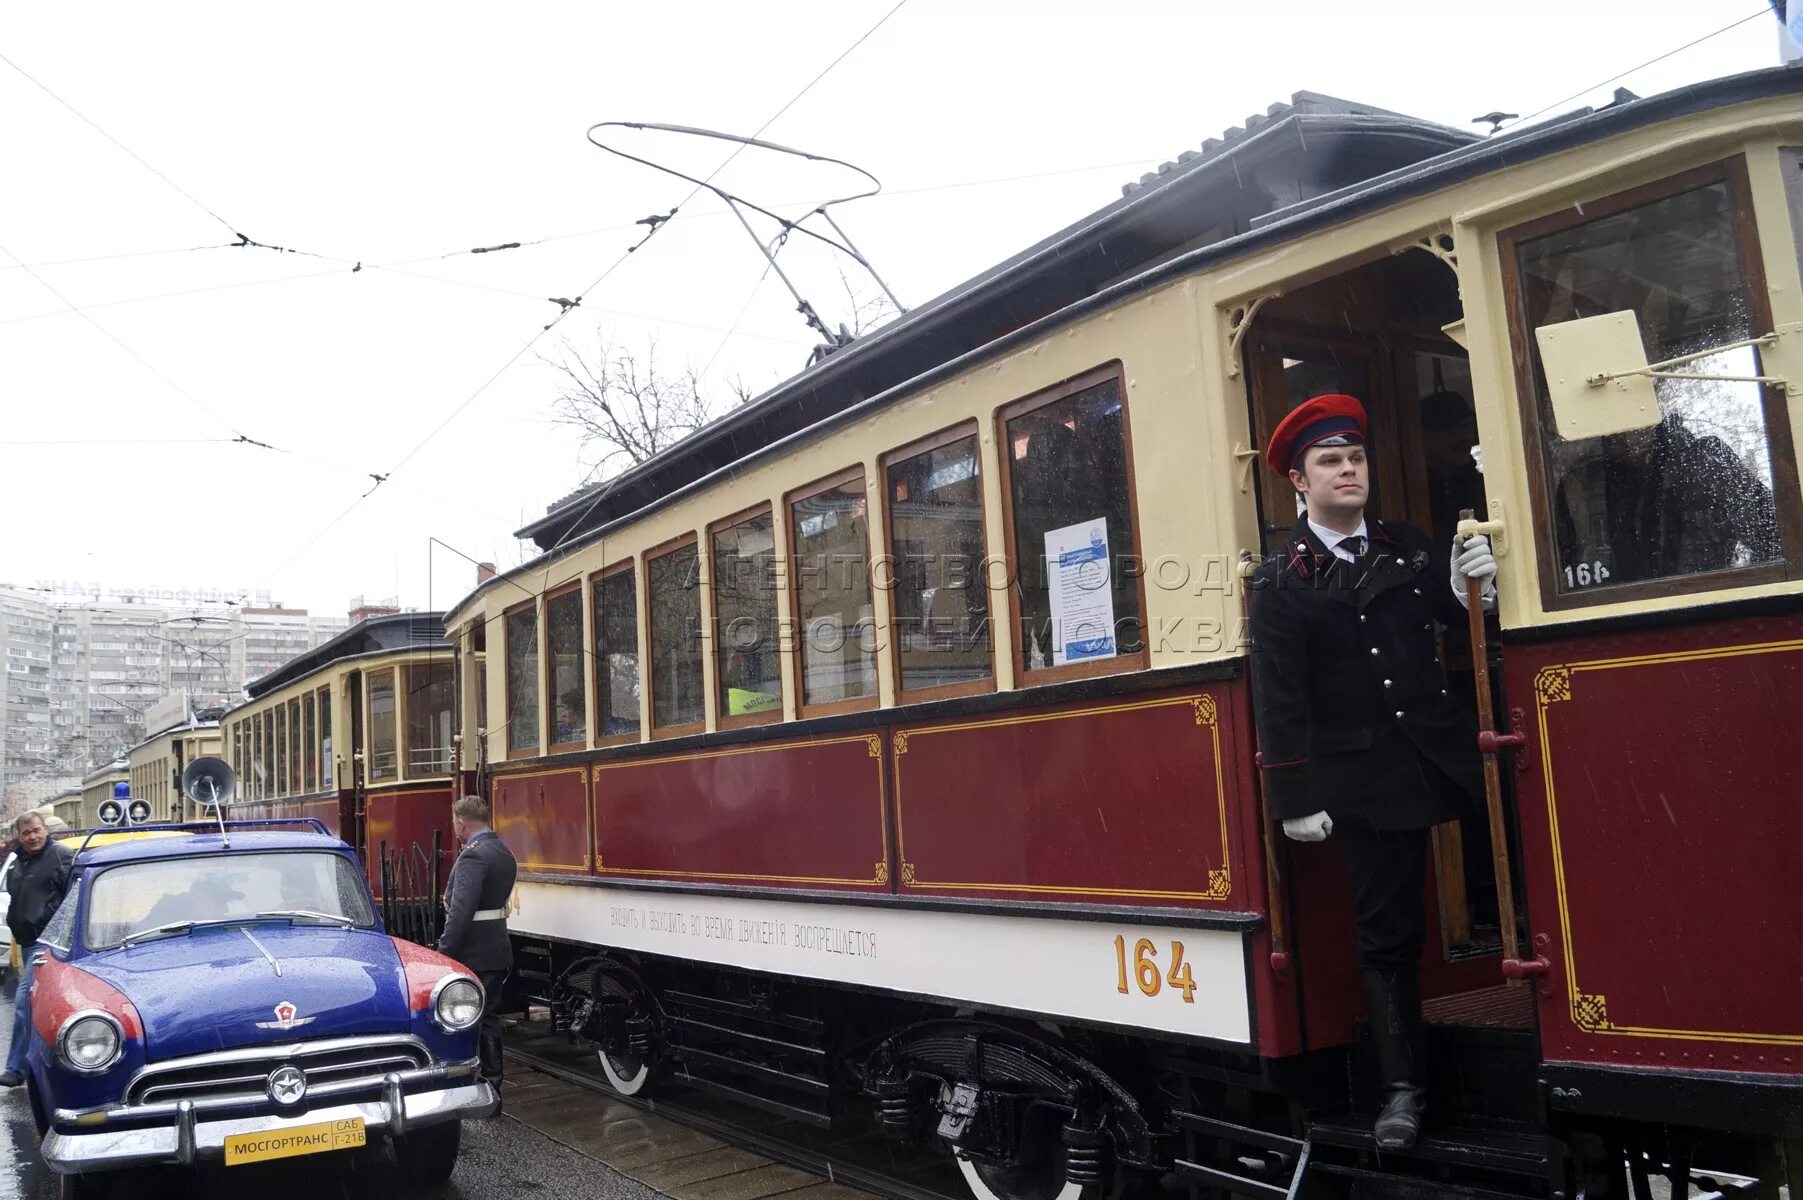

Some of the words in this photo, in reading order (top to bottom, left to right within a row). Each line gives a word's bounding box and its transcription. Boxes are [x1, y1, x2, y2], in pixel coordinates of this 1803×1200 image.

[1564, 560, 1610, 588] 164
[649, 910, 687, 934] ВЫХОДИТЬ
[690, 914, 701, 936] ВО
[704, 916, 734, 940] ВРЕМЯ
[794, 924, 877, 959] ВОСПРЕЩАЕТСЯ
[1114, 934, 1197, 1003] 164
[336, 1121, 358, 1131] САБ
[234, 1132, 329, 1155] МОСГОРТРАНС
